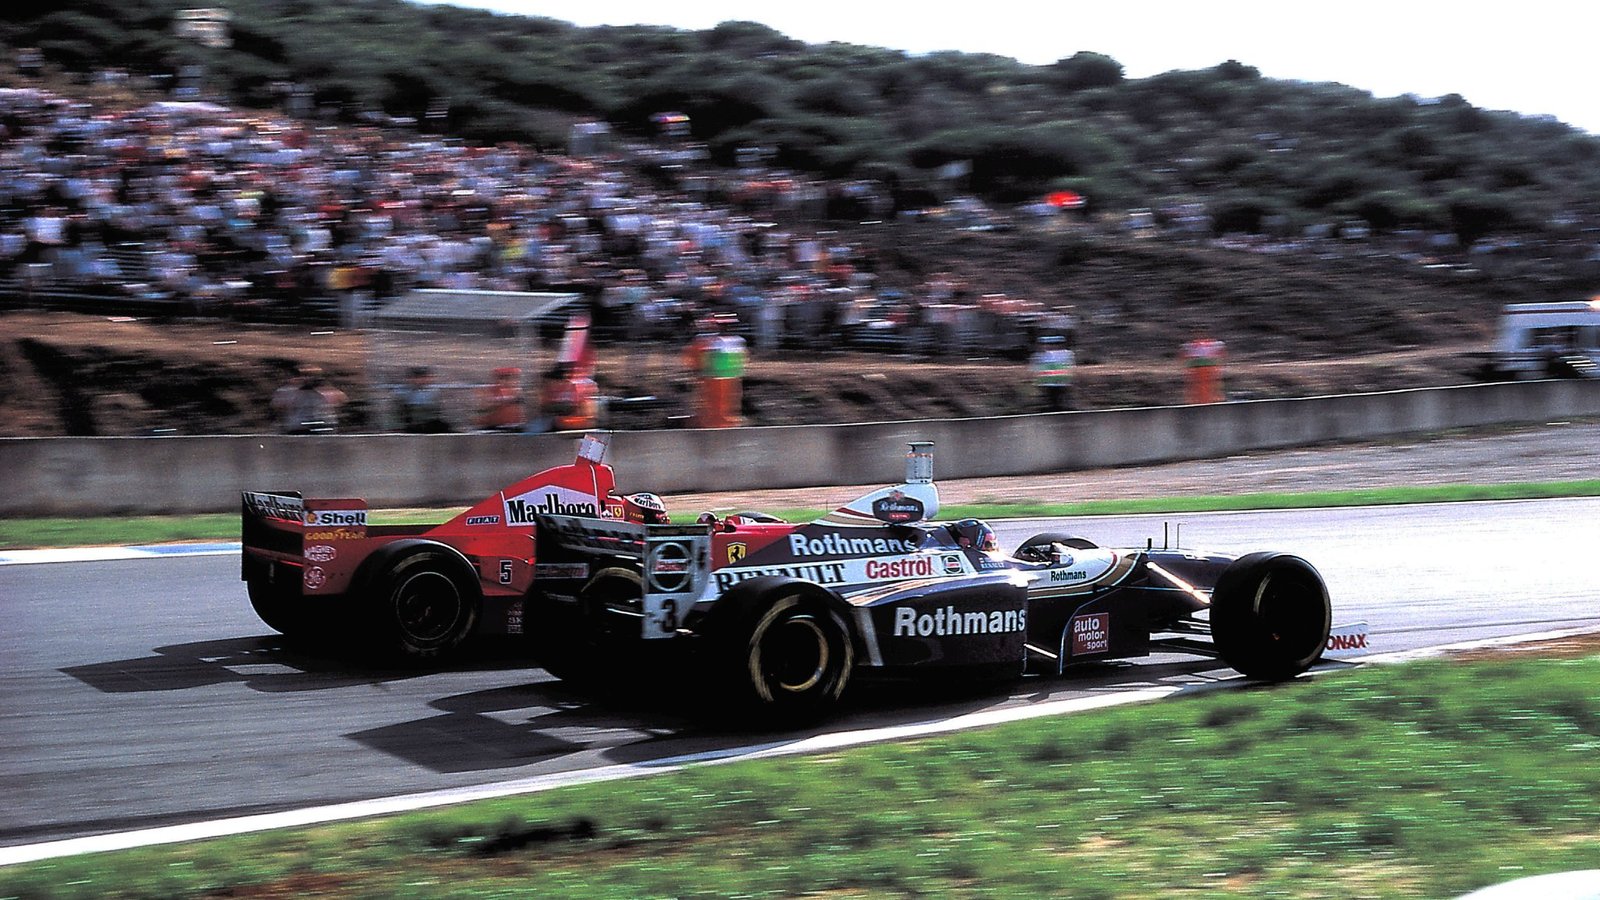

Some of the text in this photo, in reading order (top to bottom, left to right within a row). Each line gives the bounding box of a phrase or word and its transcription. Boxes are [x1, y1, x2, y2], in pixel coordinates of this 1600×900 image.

[320, 512, 366, 525] Shell
[507, 493, 597, 523] Marlboro
[467, 516, 499, 525] FIAT
[789, 532, 917, 556] Rothmans
[500, 560, 512, 584] 5
[865, 556, 932, 579] Castrol
[1050, 570, 1087, 582] Rothmans
[660, 598, 677, 633] 3
[893, 605, 1026, 637] Rothmans
[1074, 617, 1100, 633] auto
[1078, 631, 1105, 642] motor
